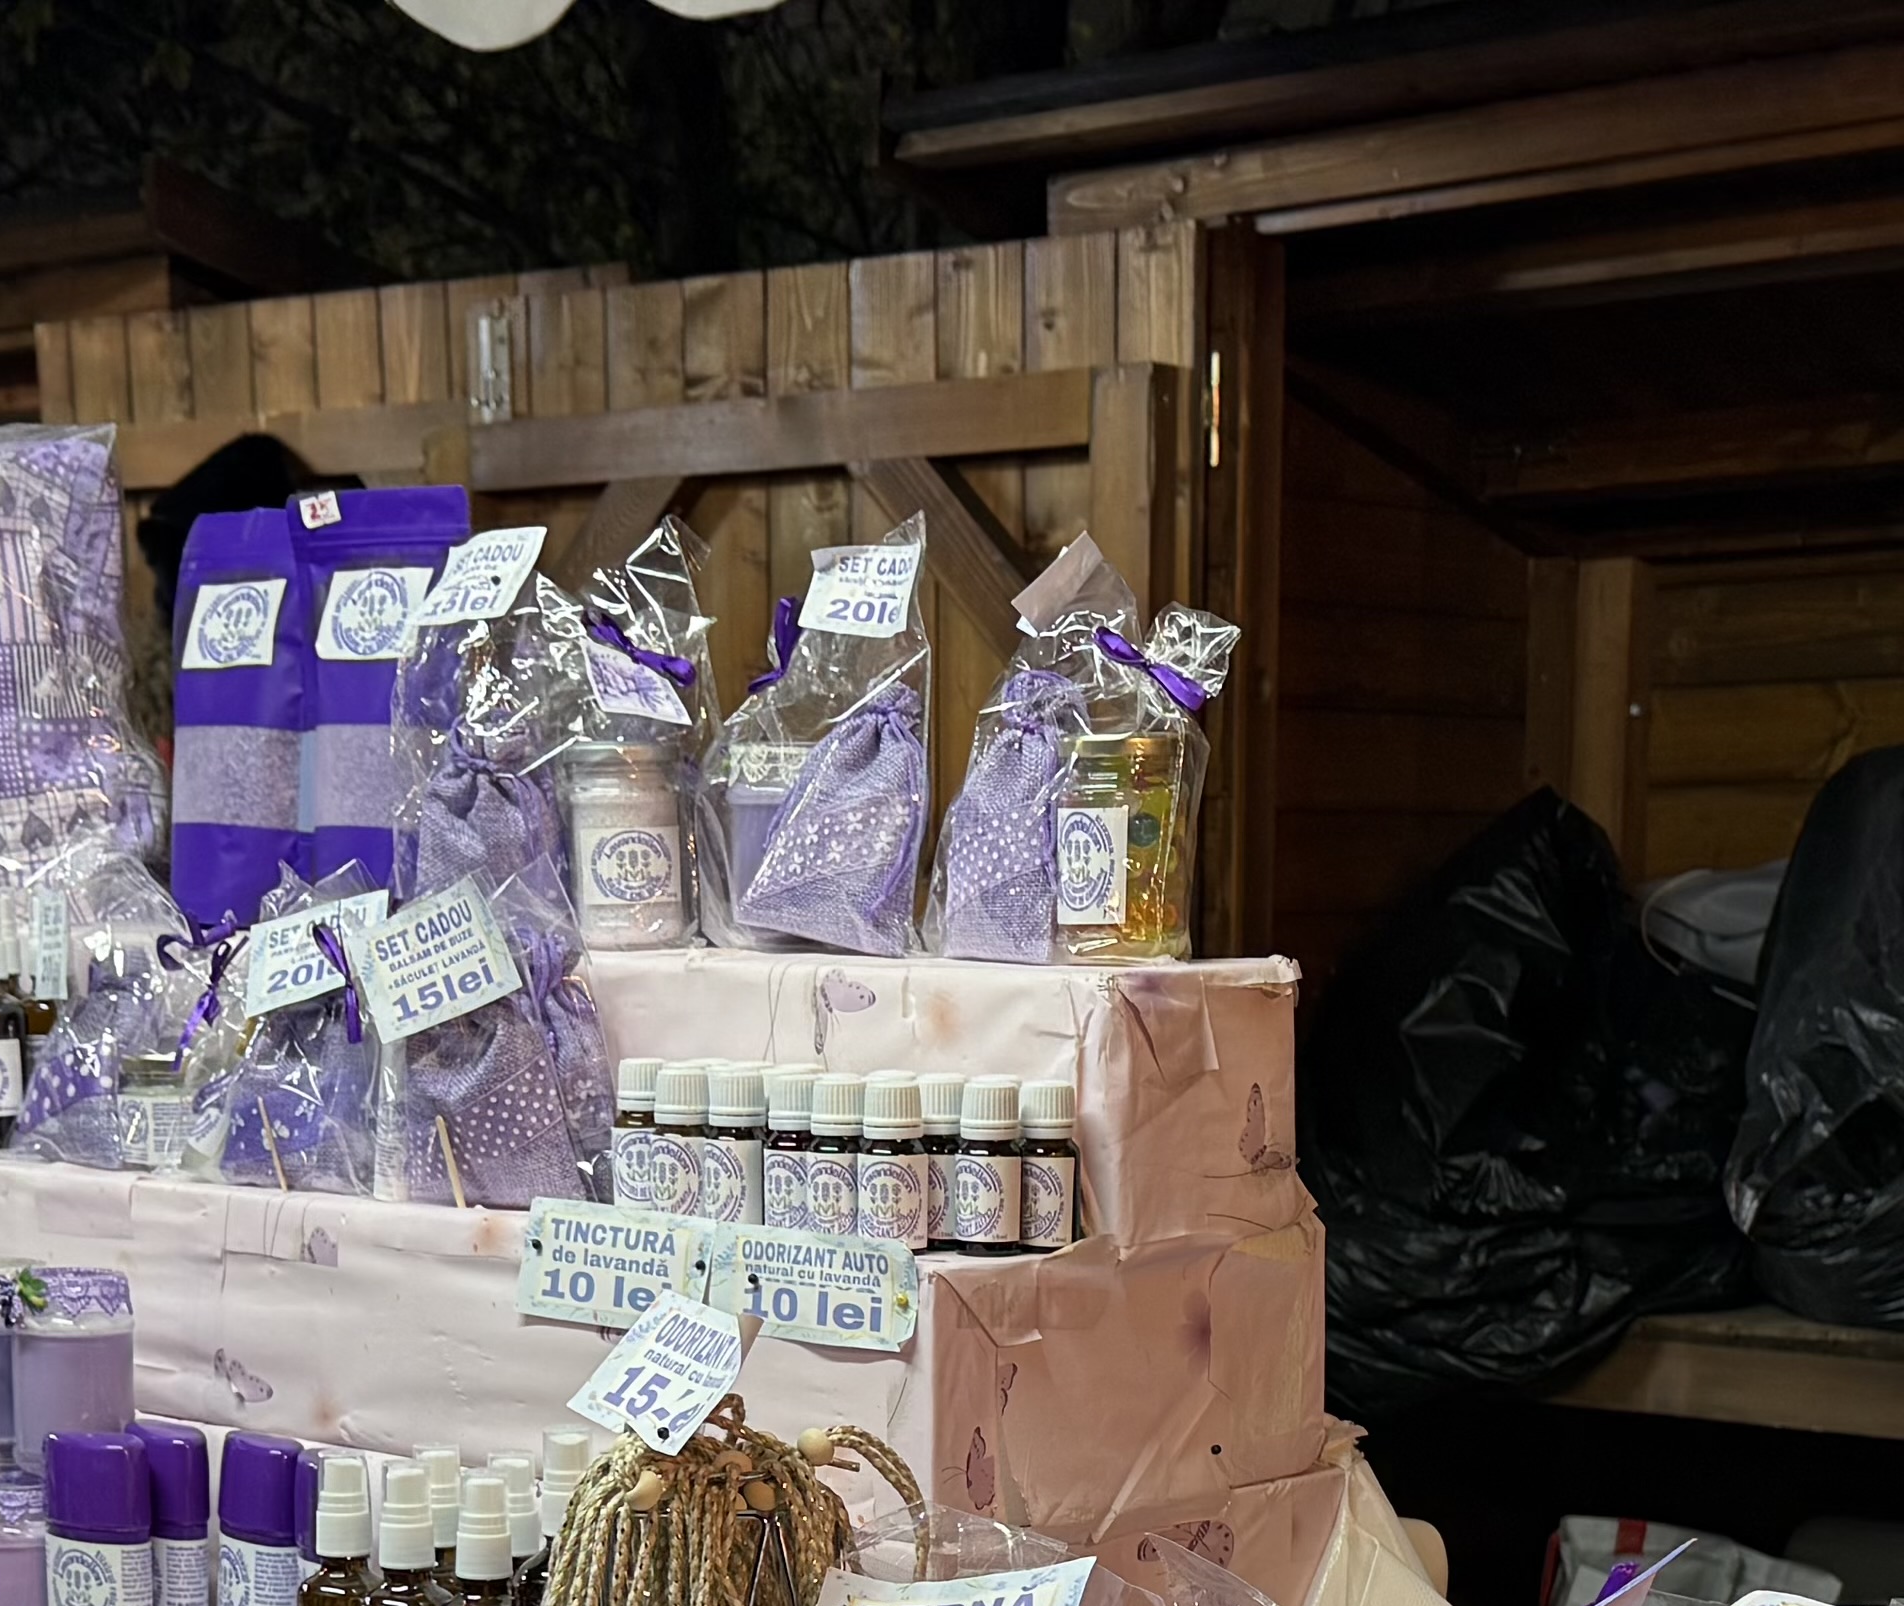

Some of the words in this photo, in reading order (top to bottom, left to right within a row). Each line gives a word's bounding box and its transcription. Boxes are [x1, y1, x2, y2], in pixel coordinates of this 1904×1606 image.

[473, 543, 525, 564] CADOU
[839, 556, 873, 574] SET
[269, 927, 299, 950] SET
[375, 932, 410, 962] SET
[414, 900, 473, 945] CADOU
[388, 947, 433, 973] BALSAM
[433, 942, 448, 957] DE
[448, 927, 475, 947] BUZE
[392, 957, 496, 1023] 15lei
[551, 1217, 677, 1256] TINCTURĂ
[552, 1244, 576, 1264] de
[582, 1247, 670, 1279] lavandă
[741, 1238, 838, 1269] ODORIZANT
[842, 1249, 889, 1276] AUTO
[745, 1261, 794, 1278] natural
[798, 1269, 816, 1281] cu
[819, 1270, 882, 1289] lavandă
[541, 1268, 596, 1304] 10
[742, 1285, 798, 1322] 10
[816, 1290, 884, 1333] lei
[654, 1313, 737, 1370] ODORIZANT
[643, 1348, 691, 1377] natural
[688, 1370, 705, 1385] cu
